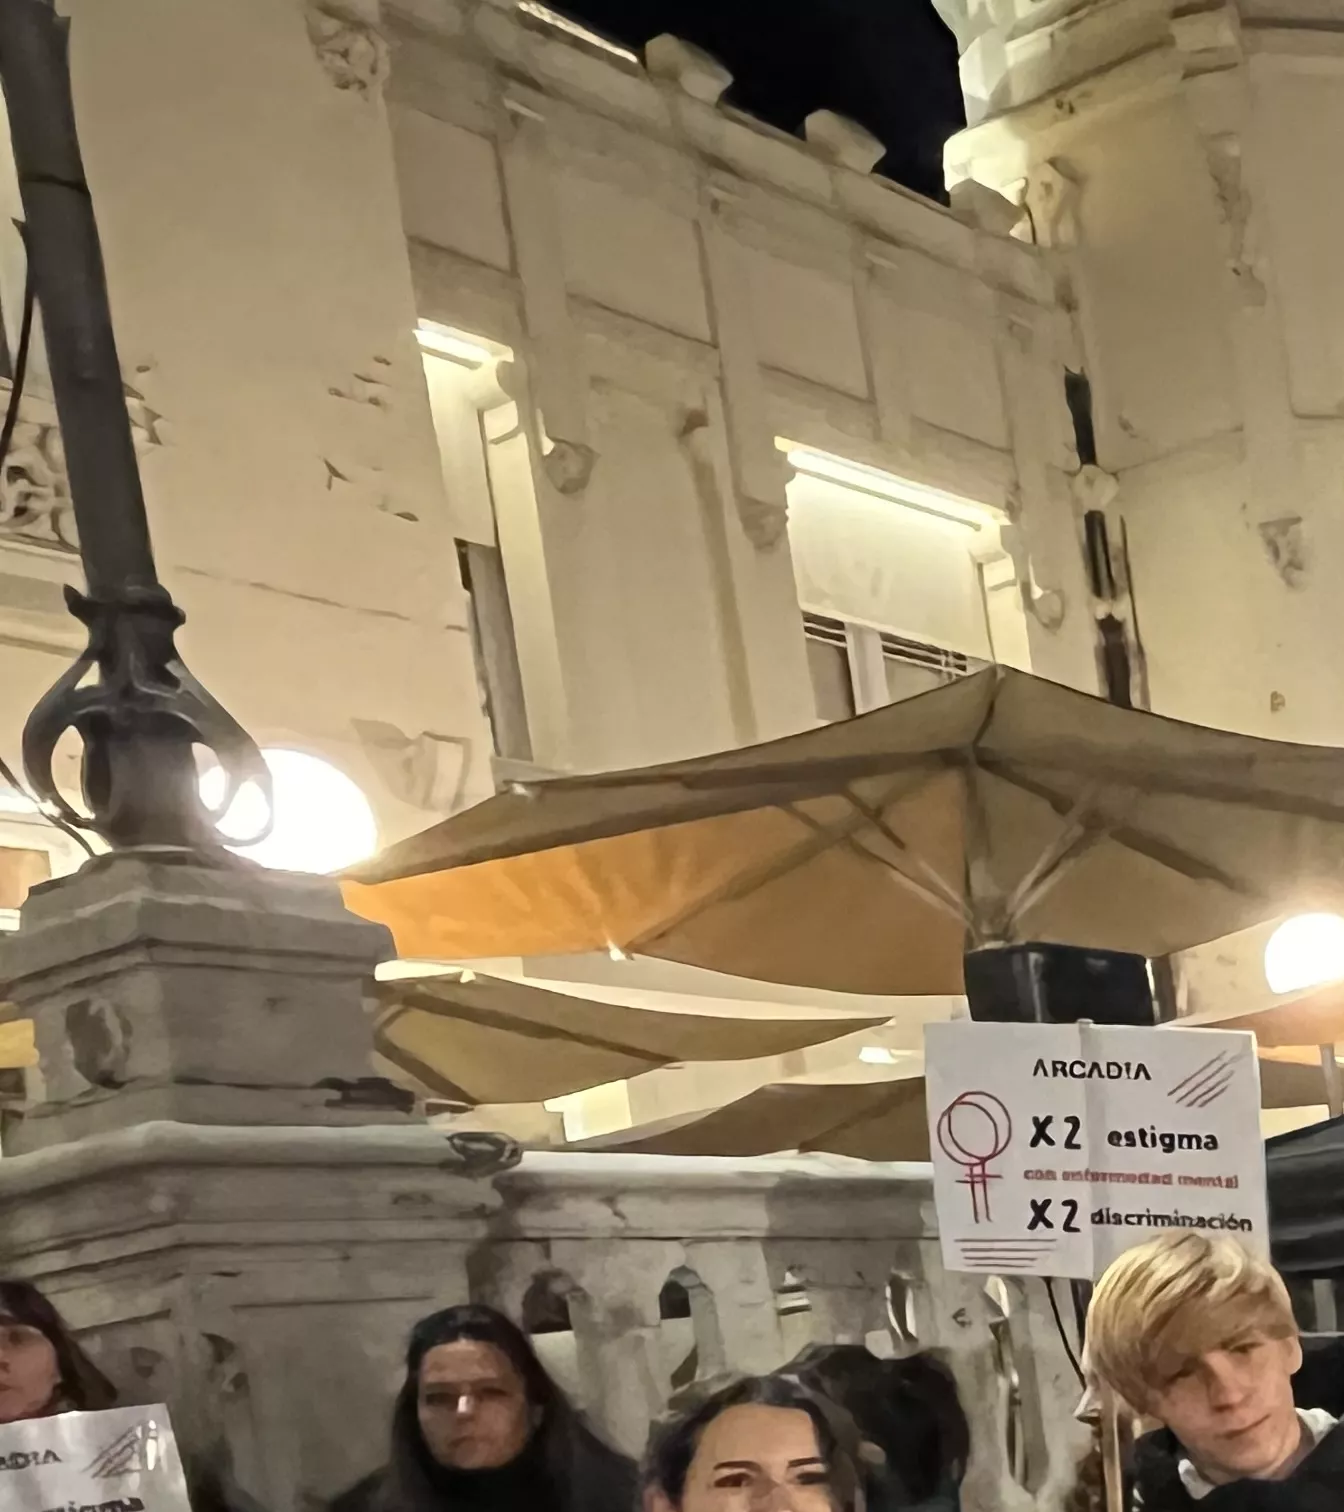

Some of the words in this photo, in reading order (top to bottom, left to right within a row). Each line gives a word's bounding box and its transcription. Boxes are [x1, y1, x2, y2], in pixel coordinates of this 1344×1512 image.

[1032, 1058, 1152, 1081] ARCADIA
[1107, 1125, 1219, 1153] estigma
[1062, 1167, 1174, 1187] enfermedad
[1178, 1174, 1240, 1190] mental
[1090, 1207, 1253, 1233] discriminación
